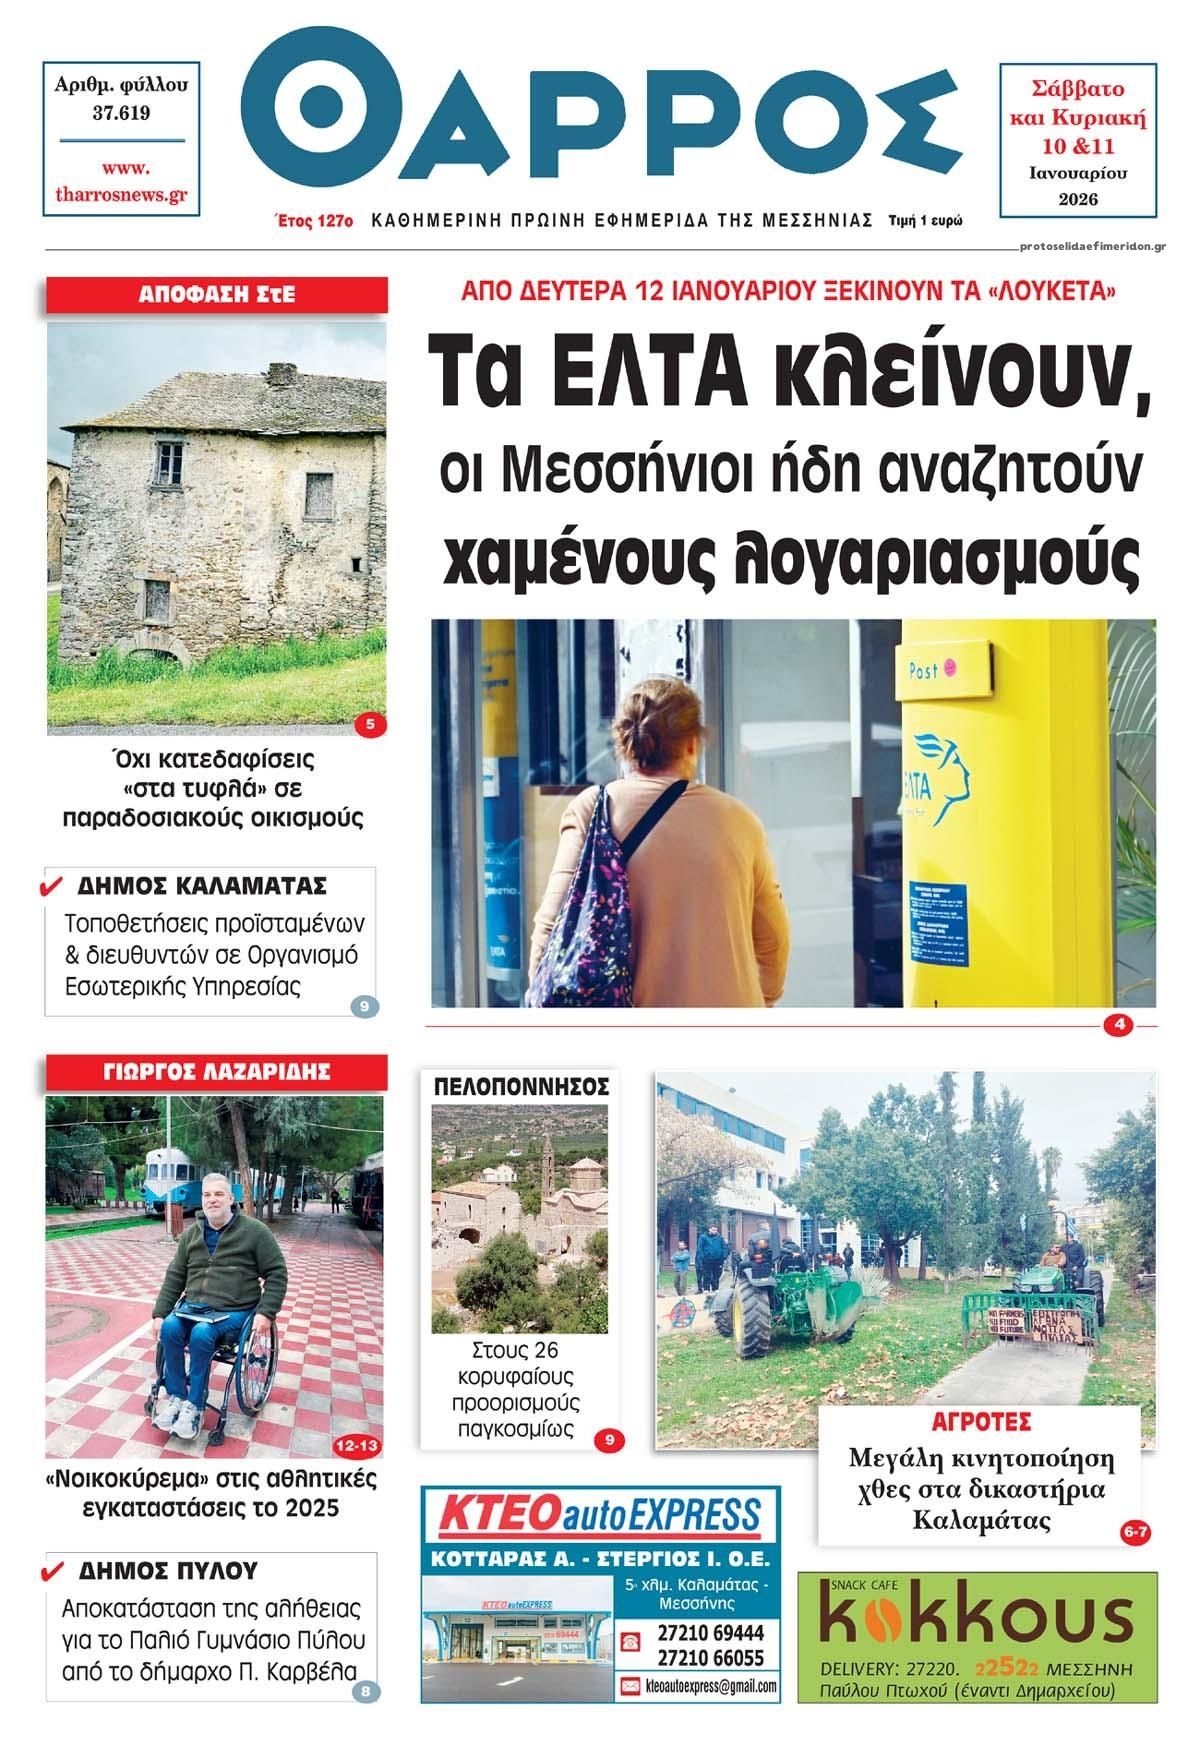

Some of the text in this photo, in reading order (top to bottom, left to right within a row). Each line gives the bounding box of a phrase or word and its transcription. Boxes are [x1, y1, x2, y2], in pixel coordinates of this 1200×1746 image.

[54, 75, 189, 96] Αριθμ. φύλλου
[1032, 79, 1125, 101] Σάββατο
[93, 105, 150, 120] 37.619
[240, 26, 963, 188] ΘΑΡΡΟΣ
[1010, 108, 1147, 130] και Κυριακή
[1043, 137, 1115, 155] 10 &11
[102, 163, 150, 175] www.
[1029, 166, 1128, 182] Ιανουαρίου
[56, 186, 188, 206] tharrosnews.gr
[1059, 193, 1098, 206] 2026
[274, 213, 353, 231] Έτος 127ο
[372, 212, 872, 227] ΚΑΘΗΜΕΡΙΝΗ ΠΡΩΙΝΗ ΕΦΗΜΕΡΙΔΑ ΤΗΣ ΜΕΣΣΗΝΙΑΣ
[888, 214, 963, 229] Τιμή 1 ευρώ
[138, 284, 296, 303] ΑΠΟΦΑΣΗ ΣτΕ
[461, 279, 1115, 301] ΑΠΟ ΔΕΥΤΕΡΑ 12 ΙΑΝΟΥΑΡΙΟΥ ΞΕΚΙΝΟΥΝ ΤΑ «ΛΟΥΚΕΤΑ»
[428, 324, 1150, 418] Τα ΕΛΤΑ κλείνουν,
[440, 440, 1144, 502] οι Μεσσήνιοι ήδη αναζητούν
[443, 524, 1139, 595] χαμένους λογαριασμούς
[909, 662, 938, 679] Post
[366, 718, 375, 729] 5
[112, 748, 314, 772] Όχι κατεδαφίσεις
[124, 777, 302, 801] «στα τυφλά» σε
[63, 806, 364, 830] παραδοσιακούς οικισμούς
[77, 876, 327, 895] ΔΗΜΟΣ ΚΑΛΑΜΑΤΑΣ
[64, 912, 365, 936] Τοποθετήσεις προϊσταμένων
[65, 944, 358, 968] & διευθυντών σε Οργανισμό
[66, 975, 301, 999] Εσωτερικής Υπηρεσίας
[360, 1001, 369, 1011] 9
[1115, 1018, 1127, 1030] 4
[103, 1062, 331, 1081] ΓΙΩΡΓΟΣ ΛΑΖΑΡΙΔΗΣ
[435, 1077, 610, 1096] ΠΕΛΟΠΟΝΝΗΣΟΣ
[473, 1341, 558, 1361] Στους 26
[459, 1366, 574, 1388] κορυφαίους
[453, 1393, 580, 1414] προορισμούς
[459, 1419, 574, 1440] παγκοσμίως
[932, 1411, 1032, 1432] ΑΓΡΟΤΕΣ
[337, 1441, 378, 1452] 12-13
[605, 1434, 615, 1445] 9
[849, 1446, 1115, 1475] Μεγάλη κινητοποίηση
[46, 1467, 377, 1491] «Νοικοκύρεμα» στις αθλητικές
[858, 1477, 1106, 1506] χθες στα δικαστήρια
[83, 1496, 339, 1520] εγκαταστάσεις το 2025
[912, 1509, 1051, 1537] Καλαμάτας
[1124, 1526, 1147, 1538] 6-7
[432, 1551, 547, 1567] ΚΟΤΤΑΡΑΣ
[553, 1551, 575, 1566] Α.
[597, 1551, 700, 1567] ΣΤΕΡΓΙΟΣ
[708, 1551, 721, 1566] Ι.
[729, 1551, 770, 1567] Ο.Ε.
[79, 1561, 258, 1580] ΔΗΜΟΣ ΠΥΛΟΥ
[642, 1579, 672, 1593] χλμ.
[678, 1577, 758, 1593] Καλαμάτας
[832, 1580, 898, 1590] SNACK CAFE
[61, 1597, 361, 1621] Αποκατάσταση της αλήθειας
[660, 1596, 735, 1611] Μεσσήνης
[62, 1629, 365, 1653] για το Παλιό Γυμνάσιο Πύλου
[658, 1624, 764, 1641] 27210 69444
[658, 1649, 764, 1667] 27210 66055
[821, 1656, 1132, 1677] DELIVERY: 27220. 22522 ΜΕΣΣΗΝΗ
[62, 1660, 358, 1685] από το δήμαρχο Π. Καρβέλα
[361, 1686, 370, 1696] 8
[646, 1678, 777, 1696] kteoautoexpress@gmail.com
[821, 1682, 1115, 1701] Παύλου Πτωχού (έναντι Δημαρχείου)
